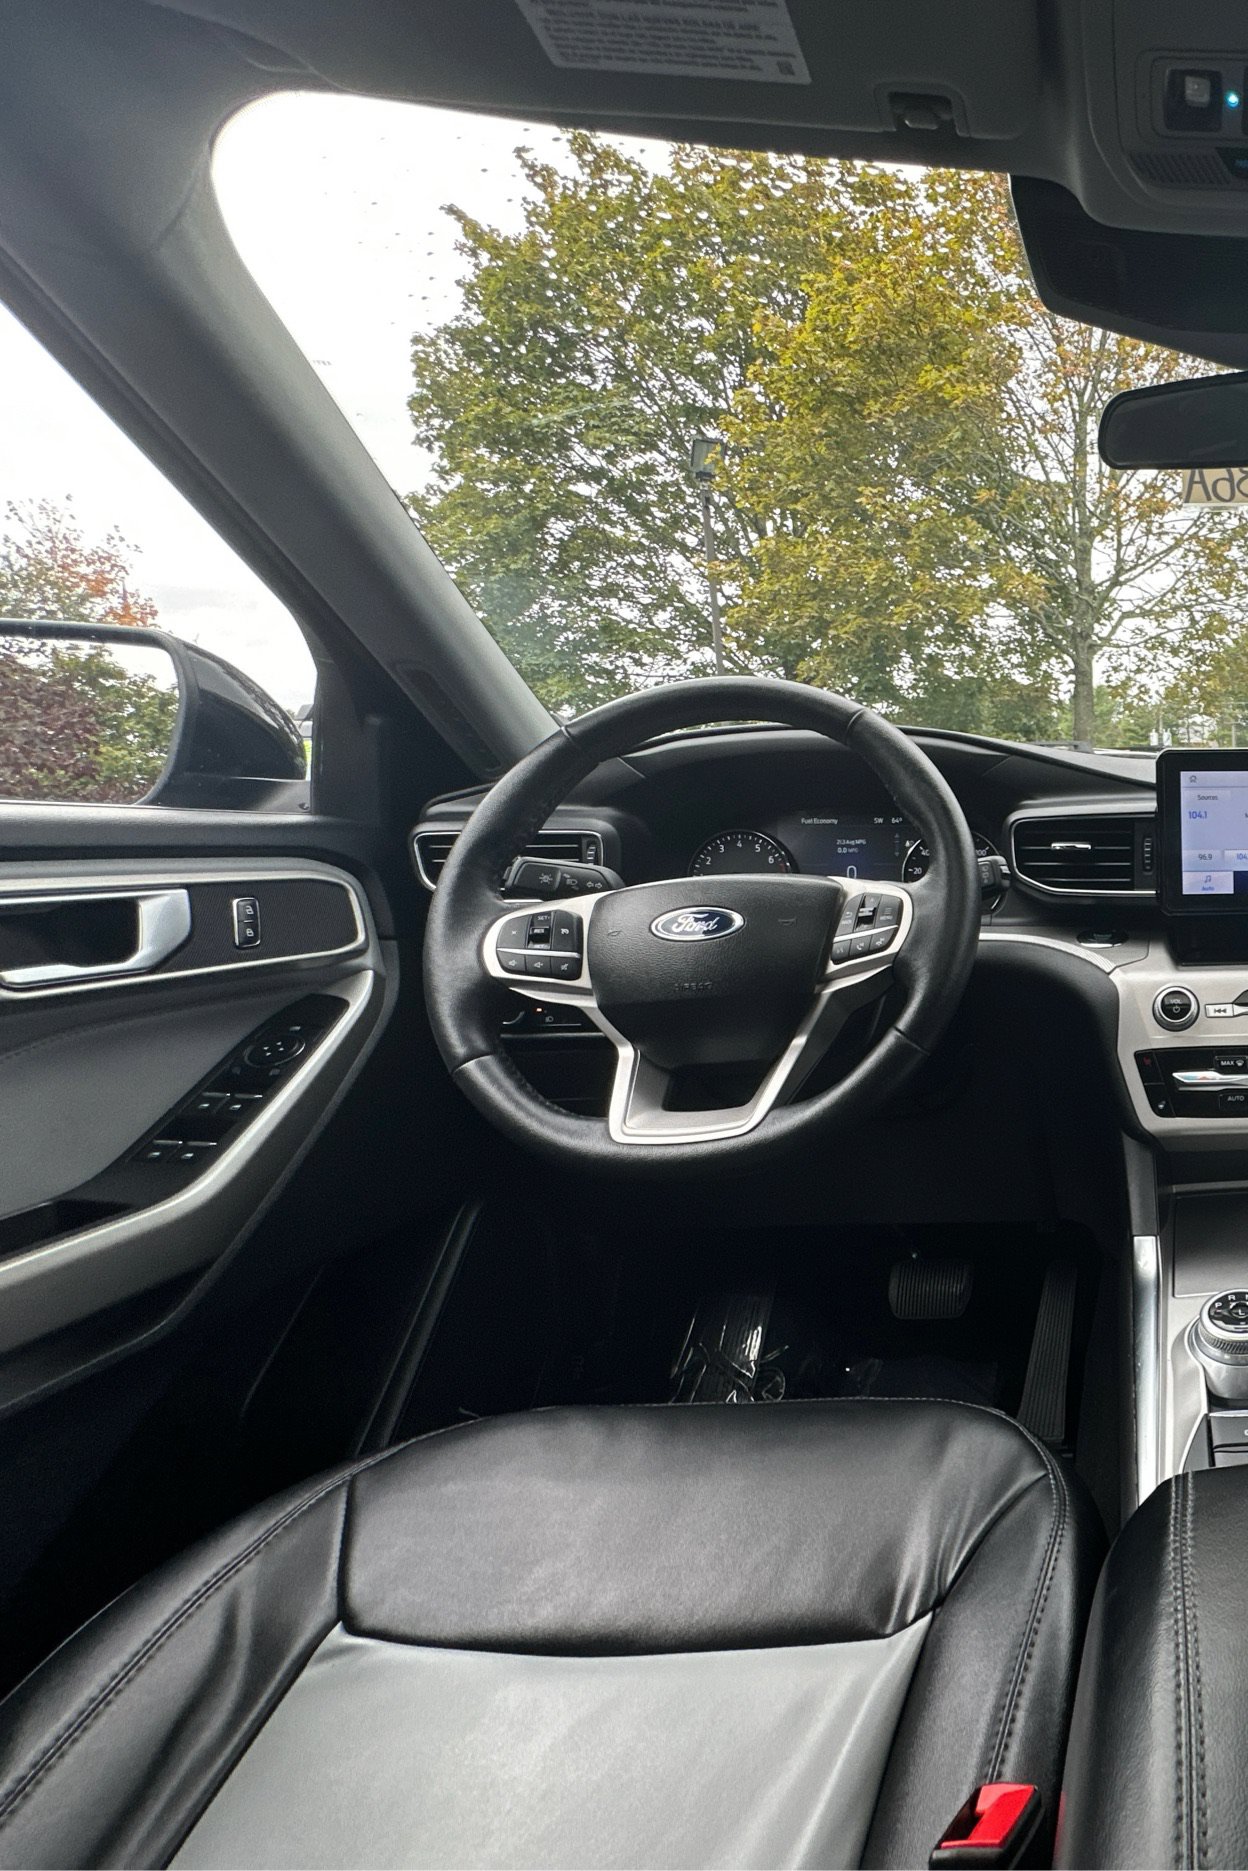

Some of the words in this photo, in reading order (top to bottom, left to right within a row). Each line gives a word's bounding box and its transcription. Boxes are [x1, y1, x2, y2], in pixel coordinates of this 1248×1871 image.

[1188, 811, 1208, 819] 104.1
[801, 817, 813, 825] Fuel
[813, 817, 838, 826] Economy
[719, 844, 725, 853] 3
[736, 840, 742, 848] 4
[755, 844, 761, 852] 5
[706, 856, 712, 865] 2
[768, 855, 774, 864] 6
[672, 913, 720, 936] Ford
